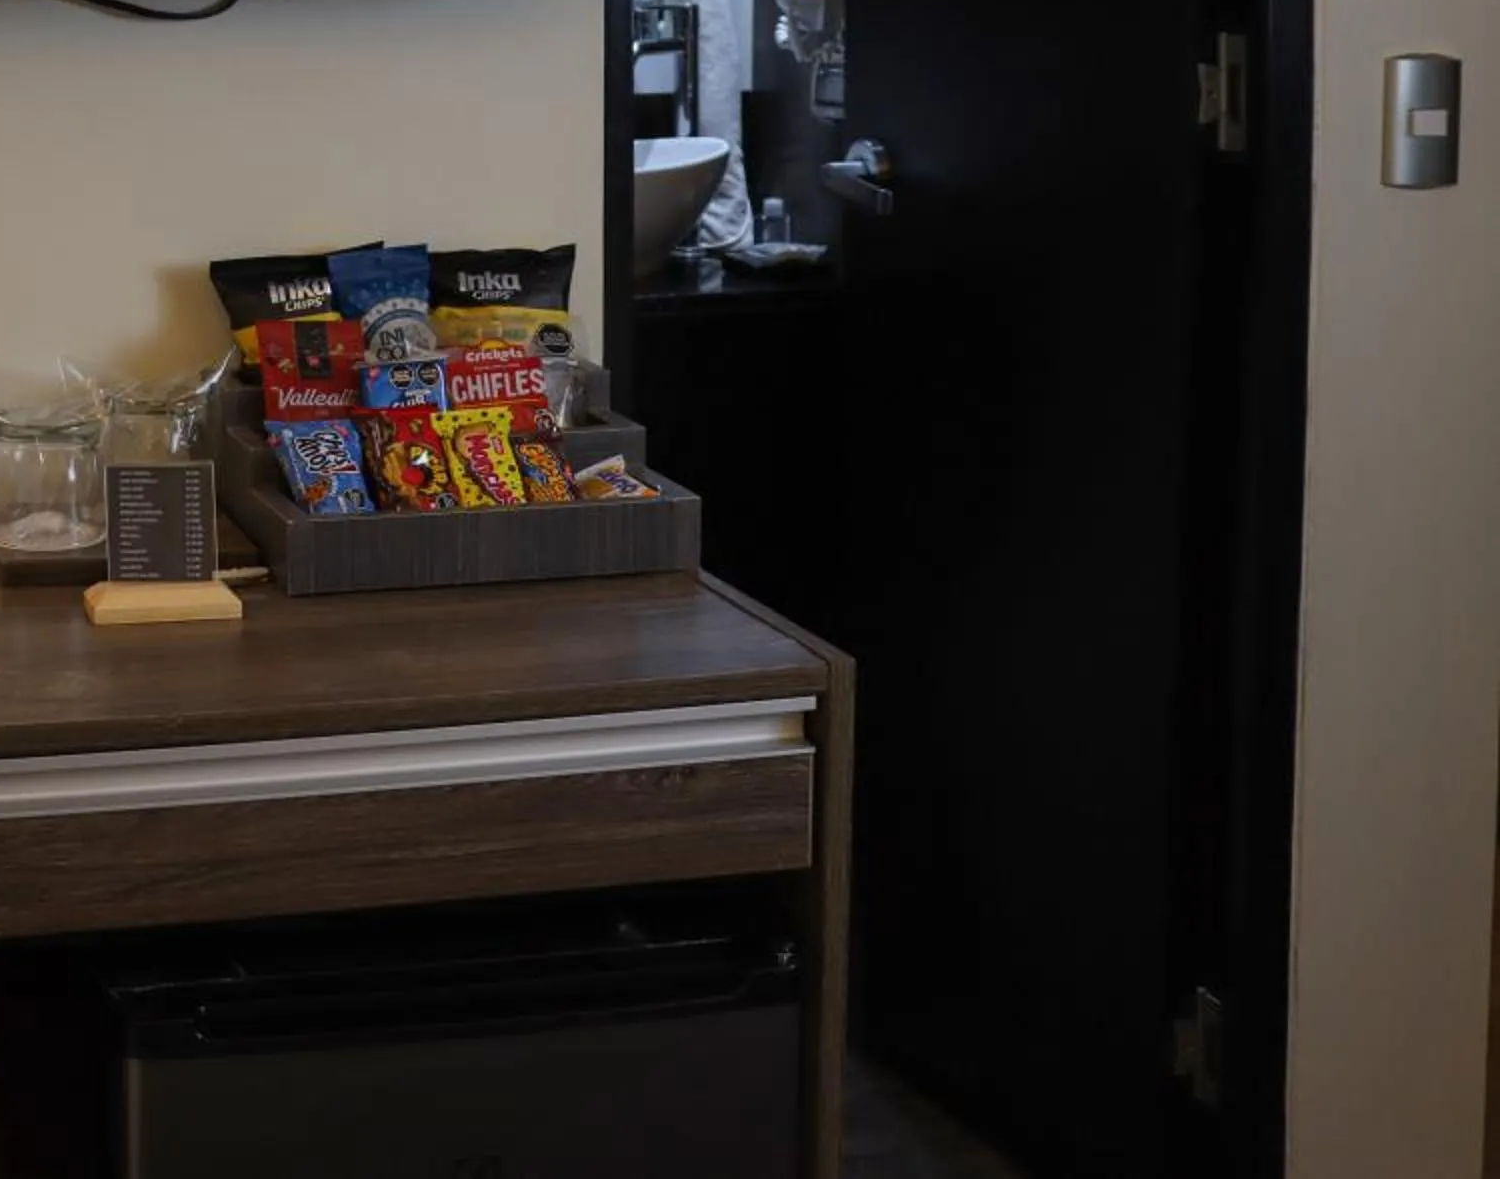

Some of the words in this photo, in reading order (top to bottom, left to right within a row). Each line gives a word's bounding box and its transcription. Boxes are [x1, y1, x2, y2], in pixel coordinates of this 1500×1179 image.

[269, 277, 332, 304] Inka
[461, 272, 521, 292] Inka
[451, 369, 547, 404] CHIFLES
